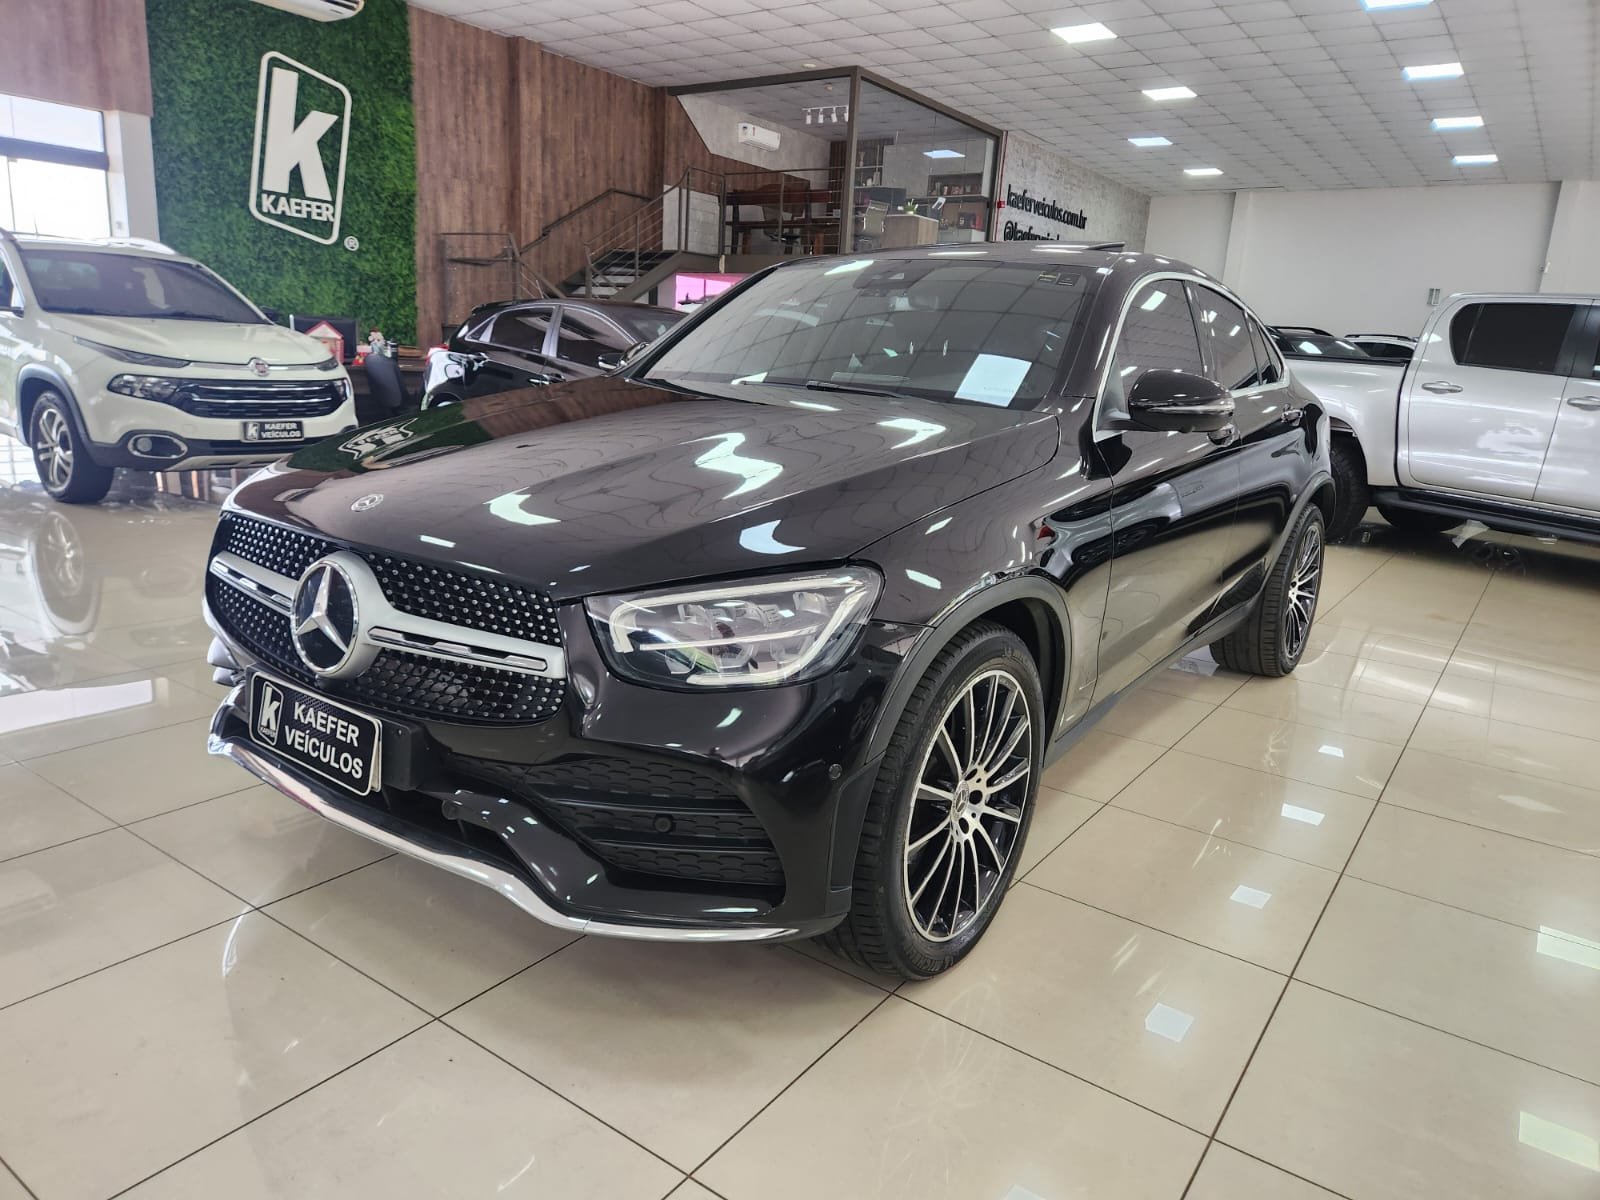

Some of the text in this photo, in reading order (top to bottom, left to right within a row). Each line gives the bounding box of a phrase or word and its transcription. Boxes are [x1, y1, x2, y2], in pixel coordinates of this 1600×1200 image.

[261, 193, 335, 222] KAEFER
[1007, 184, 1087, 229] kaeferveiculos.com.br
[294, 702, 359, 747] KAEFER
[285, 725, 363, 779] VEÍCULOS
